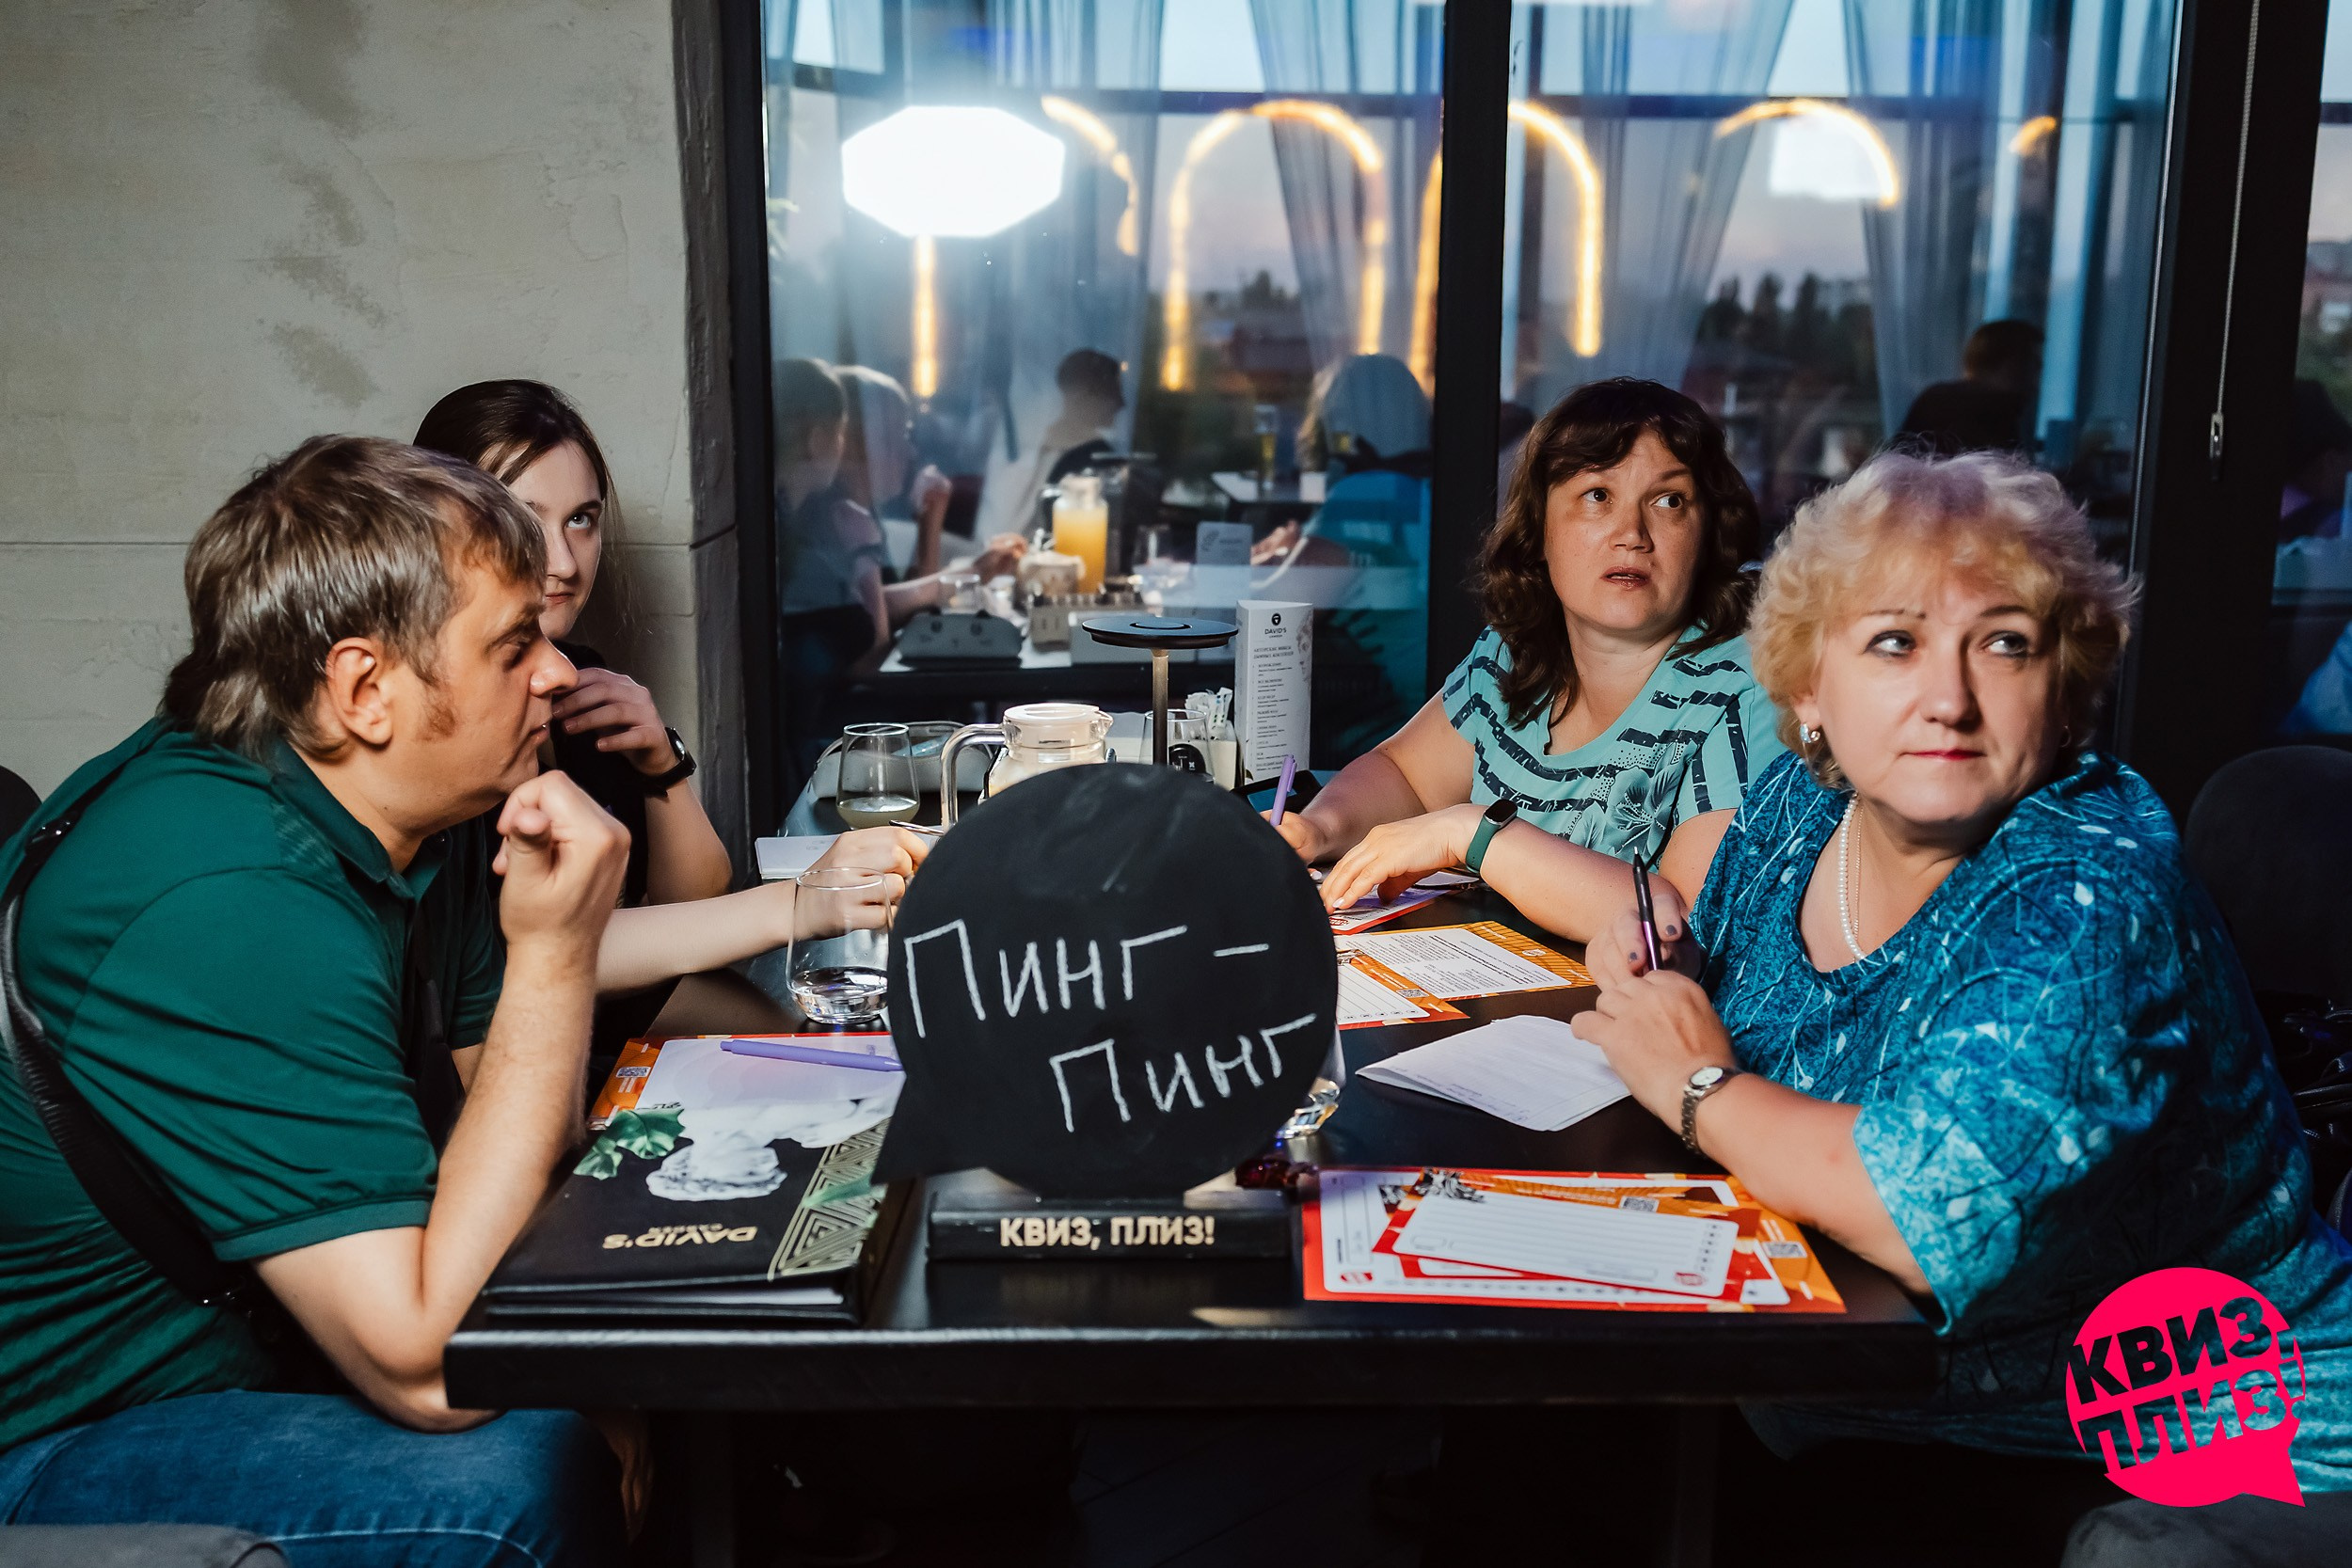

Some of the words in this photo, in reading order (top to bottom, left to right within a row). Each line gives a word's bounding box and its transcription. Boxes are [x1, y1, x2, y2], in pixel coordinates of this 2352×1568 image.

[601, 1226, 758, 1250] DAVID'S
[999, 1216, 1101, 1251] КВИЗ,
[1109, 1215, 1216, 1246] ПЛИЗ!
